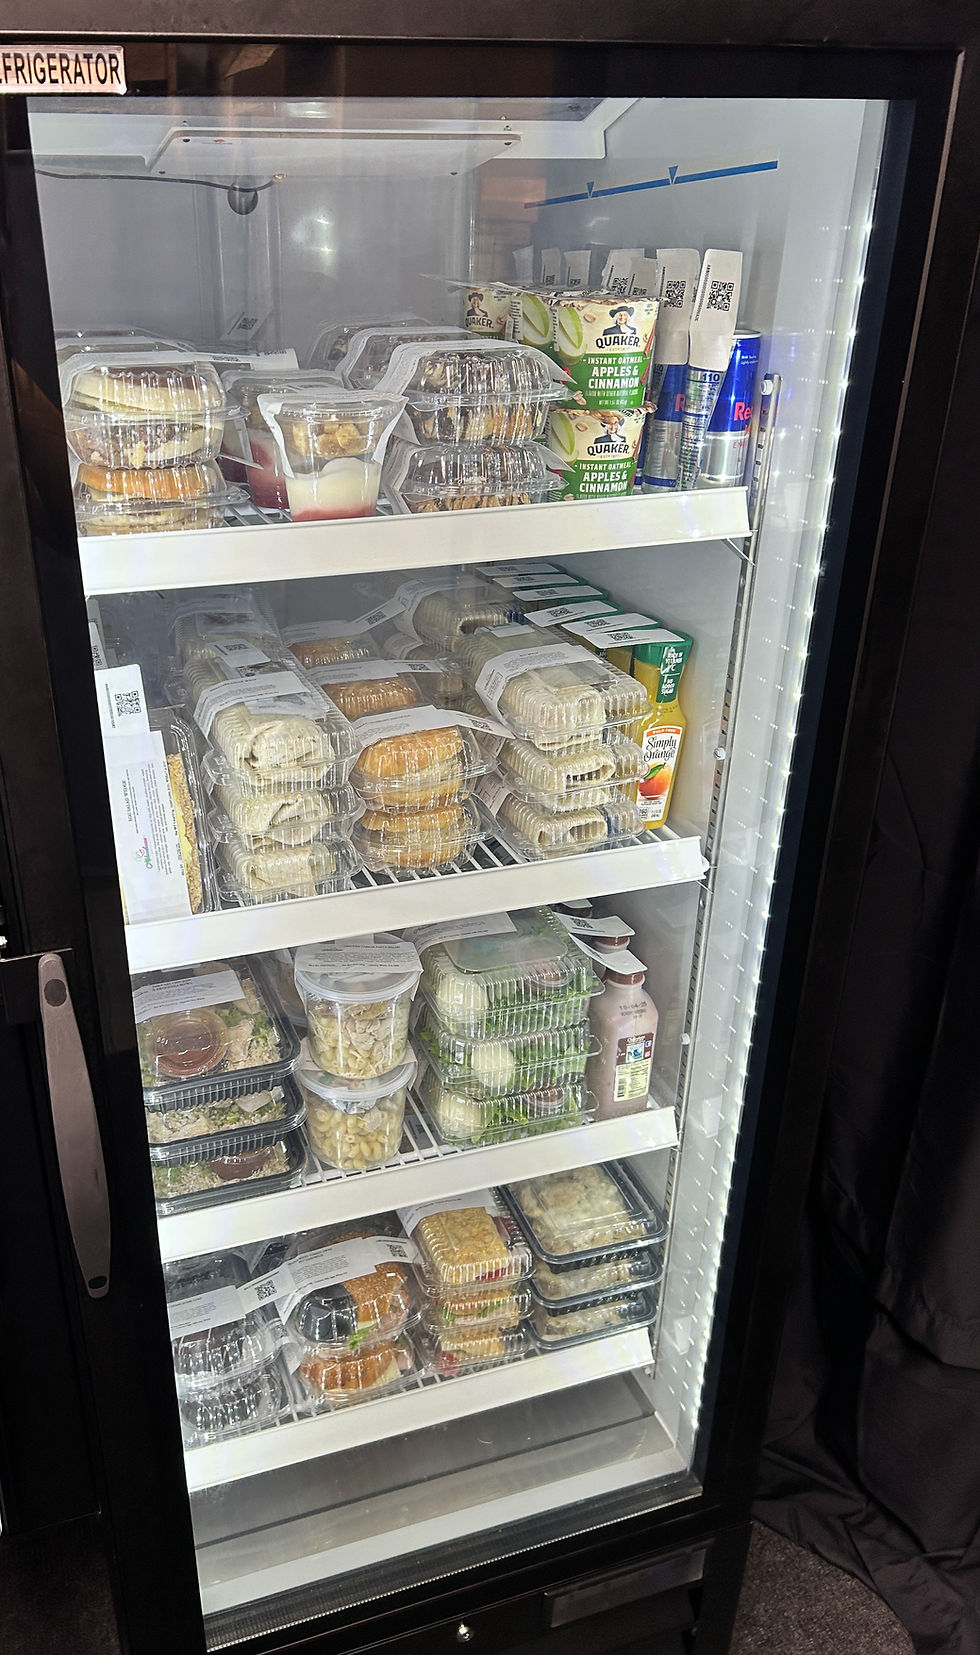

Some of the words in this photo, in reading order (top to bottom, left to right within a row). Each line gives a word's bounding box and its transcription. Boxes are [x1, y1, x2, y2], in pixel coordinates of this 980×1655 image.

[0, 53, 121, 84] FRIGERATOR
[596, 335, 640, 349] QUAKER
[588, 357, 617, 365] INSTANT
[618, 356, 643, 364] OATMEAL
[592, 366, 632, 377] APPLES
[632, 365, 639, 376] &
[588, 377, 640, 389] CINNAMON
[702, 373, 720, 382] 110
[587, 444, 630, 456] QUAKER
[580, 463, 607, 471] INSTANT
[608, 462, 632, 470] OATMEAL
[583, 471, 620, 482] APPLES
[621, 471, 628, 480] &
[579, 481, 628, 493] CINNAMON
[646, 736, 677, 750] Simply
[644, 747, 676, 762] Orange
